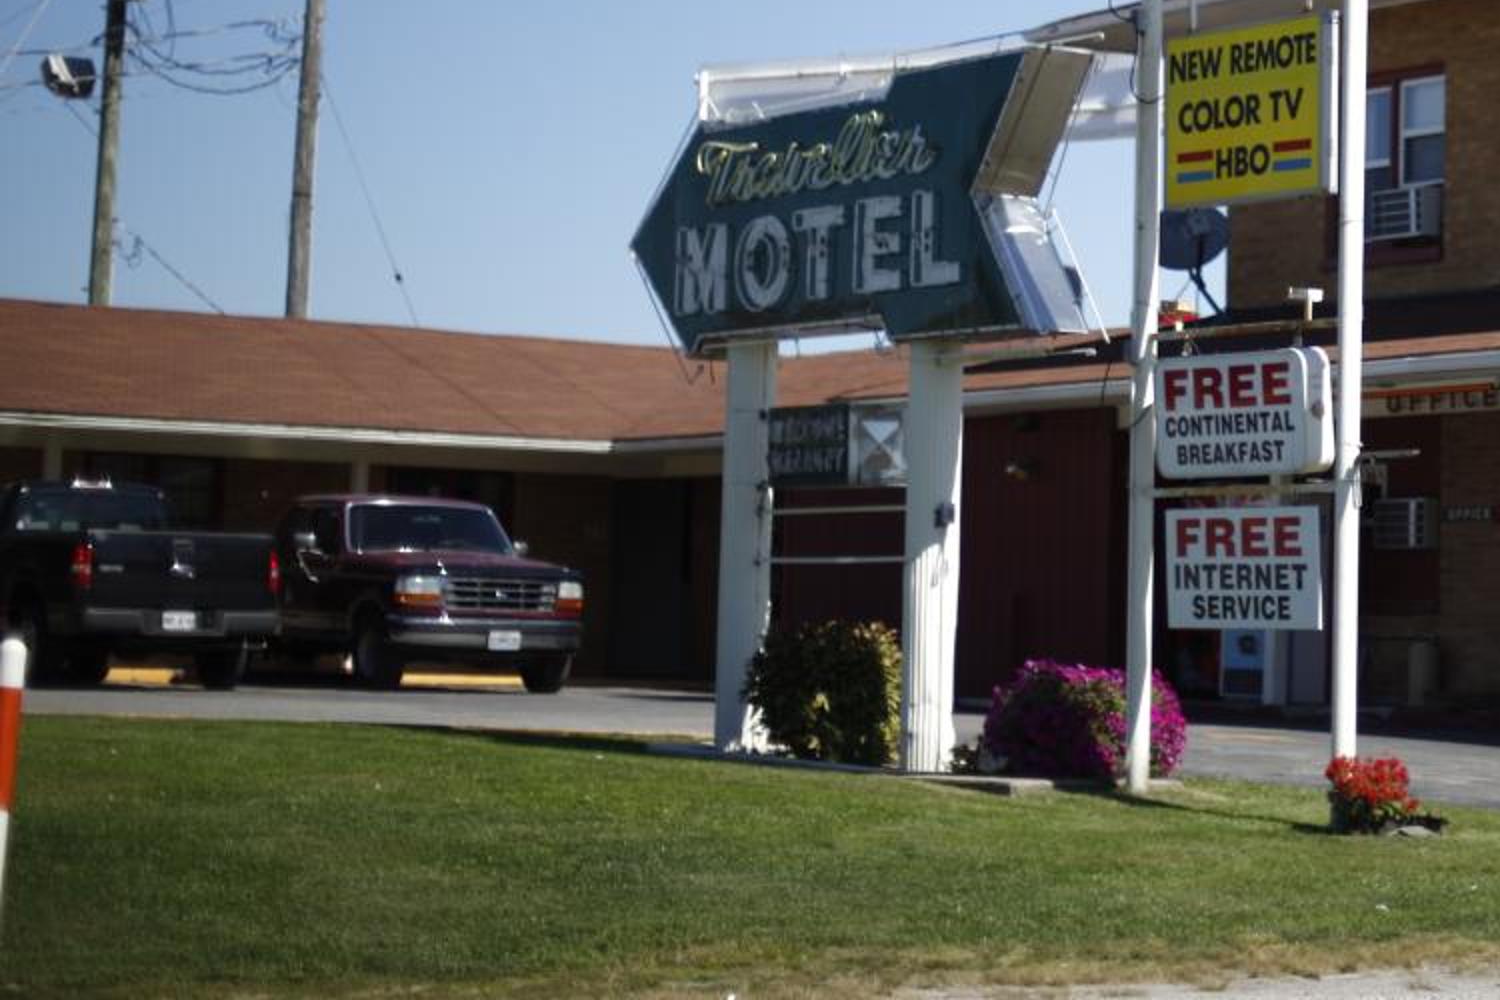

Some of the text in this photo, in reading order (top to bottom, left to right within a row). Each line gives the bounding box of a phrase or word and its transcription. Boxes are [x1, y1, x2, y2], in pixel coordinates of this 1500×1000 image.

[1169, 31, 1317, 85] NEW REMOTE
[1178, 87, 1304, 134] COLOR TV
[1215, 144, 1271, 180] HBO
[674, 189, 961, 317] MOTEL
[1163, 362, 1293, 411] FREE
[1165, 410, 1295, 438] CONTINENTAL
[1177, 440, 1285, 466] BREAKFAST
[1175, 516, 1303, 558] FREE
[1174, 563, 1307, 591] INTERNET
[1192, 595, 1292, 621] SERVICE
